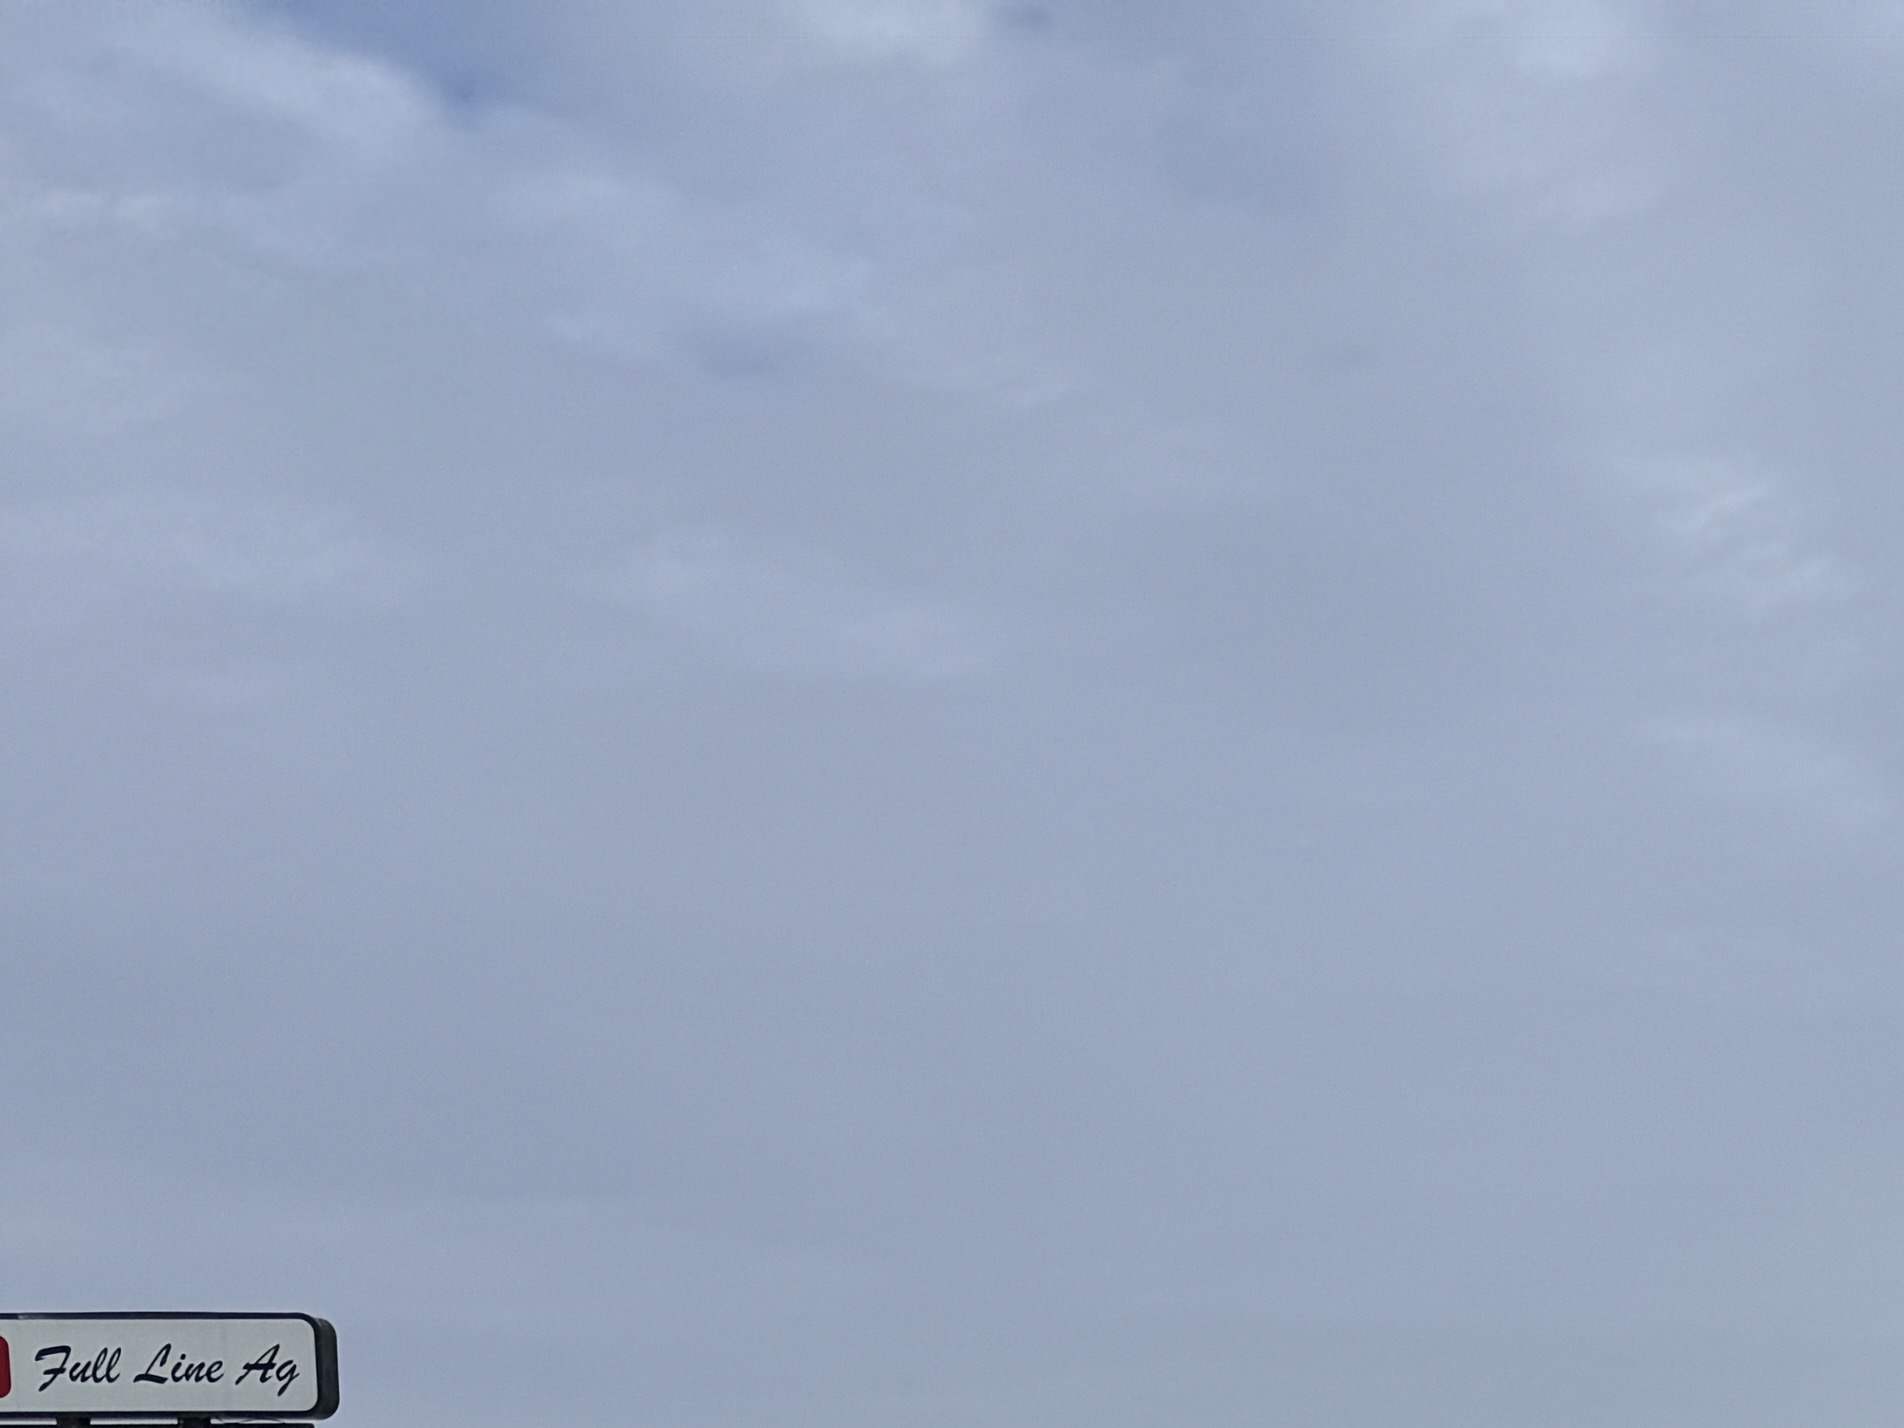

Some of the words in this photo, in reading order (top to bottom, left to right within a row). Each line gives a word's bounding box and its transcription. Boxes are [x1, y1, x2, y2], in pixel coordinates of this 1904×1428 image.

[34, 1345, 122, 1392] Full
[133, 1343, 225, 1384] Line
[235, 1343, 300, 1396] Ag
